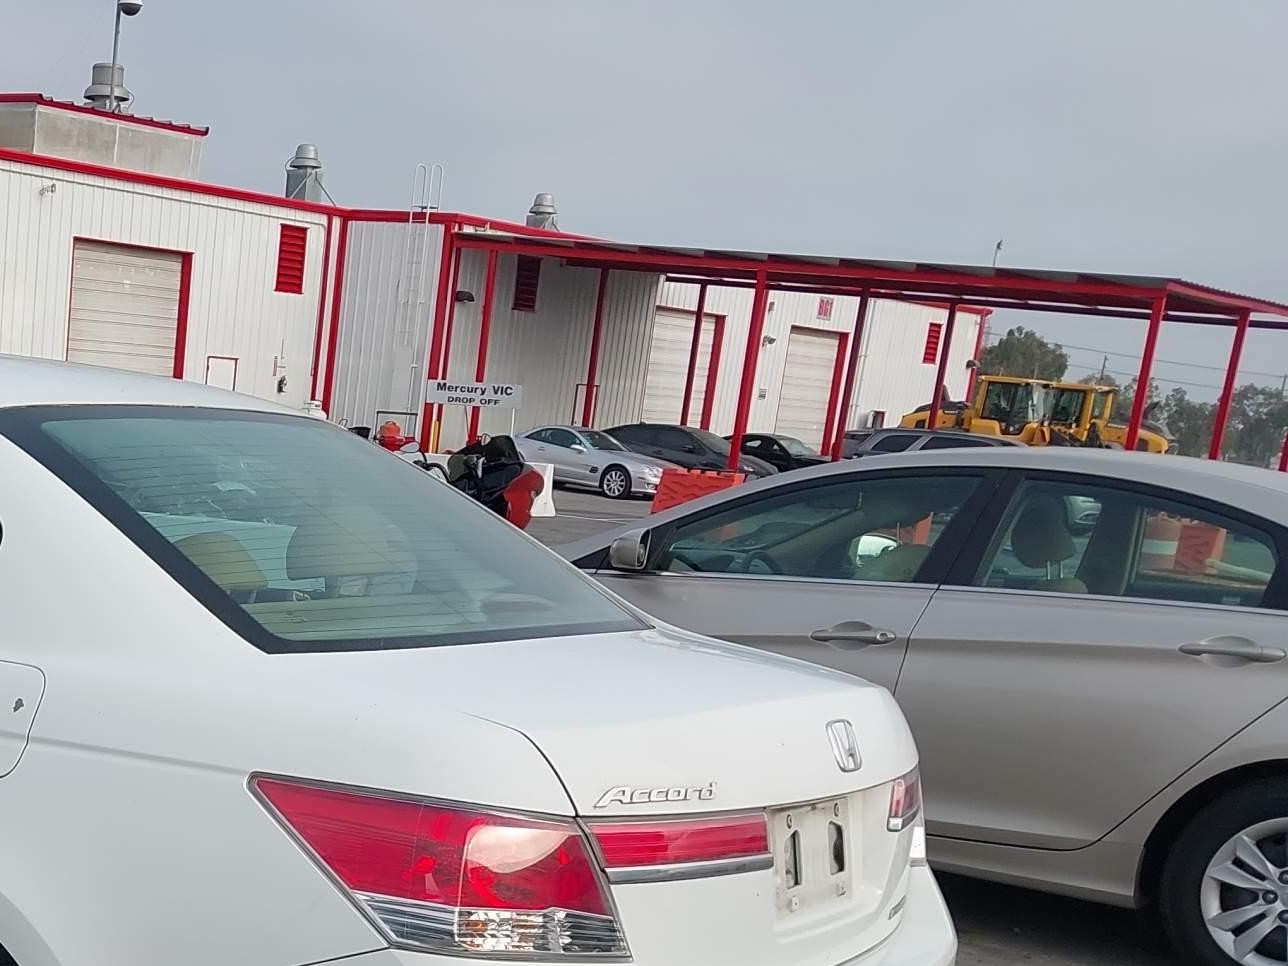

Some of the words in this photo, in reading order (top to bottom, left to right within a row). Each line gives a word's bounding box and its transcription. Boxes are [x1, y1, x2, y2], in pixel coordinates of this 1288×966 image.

[436, 382, 487, 396] Mercury
[492, 385, 513, 396] VIC
[447, 396, 475, 404] DROP
[593, 782, 717, 808] Accord
